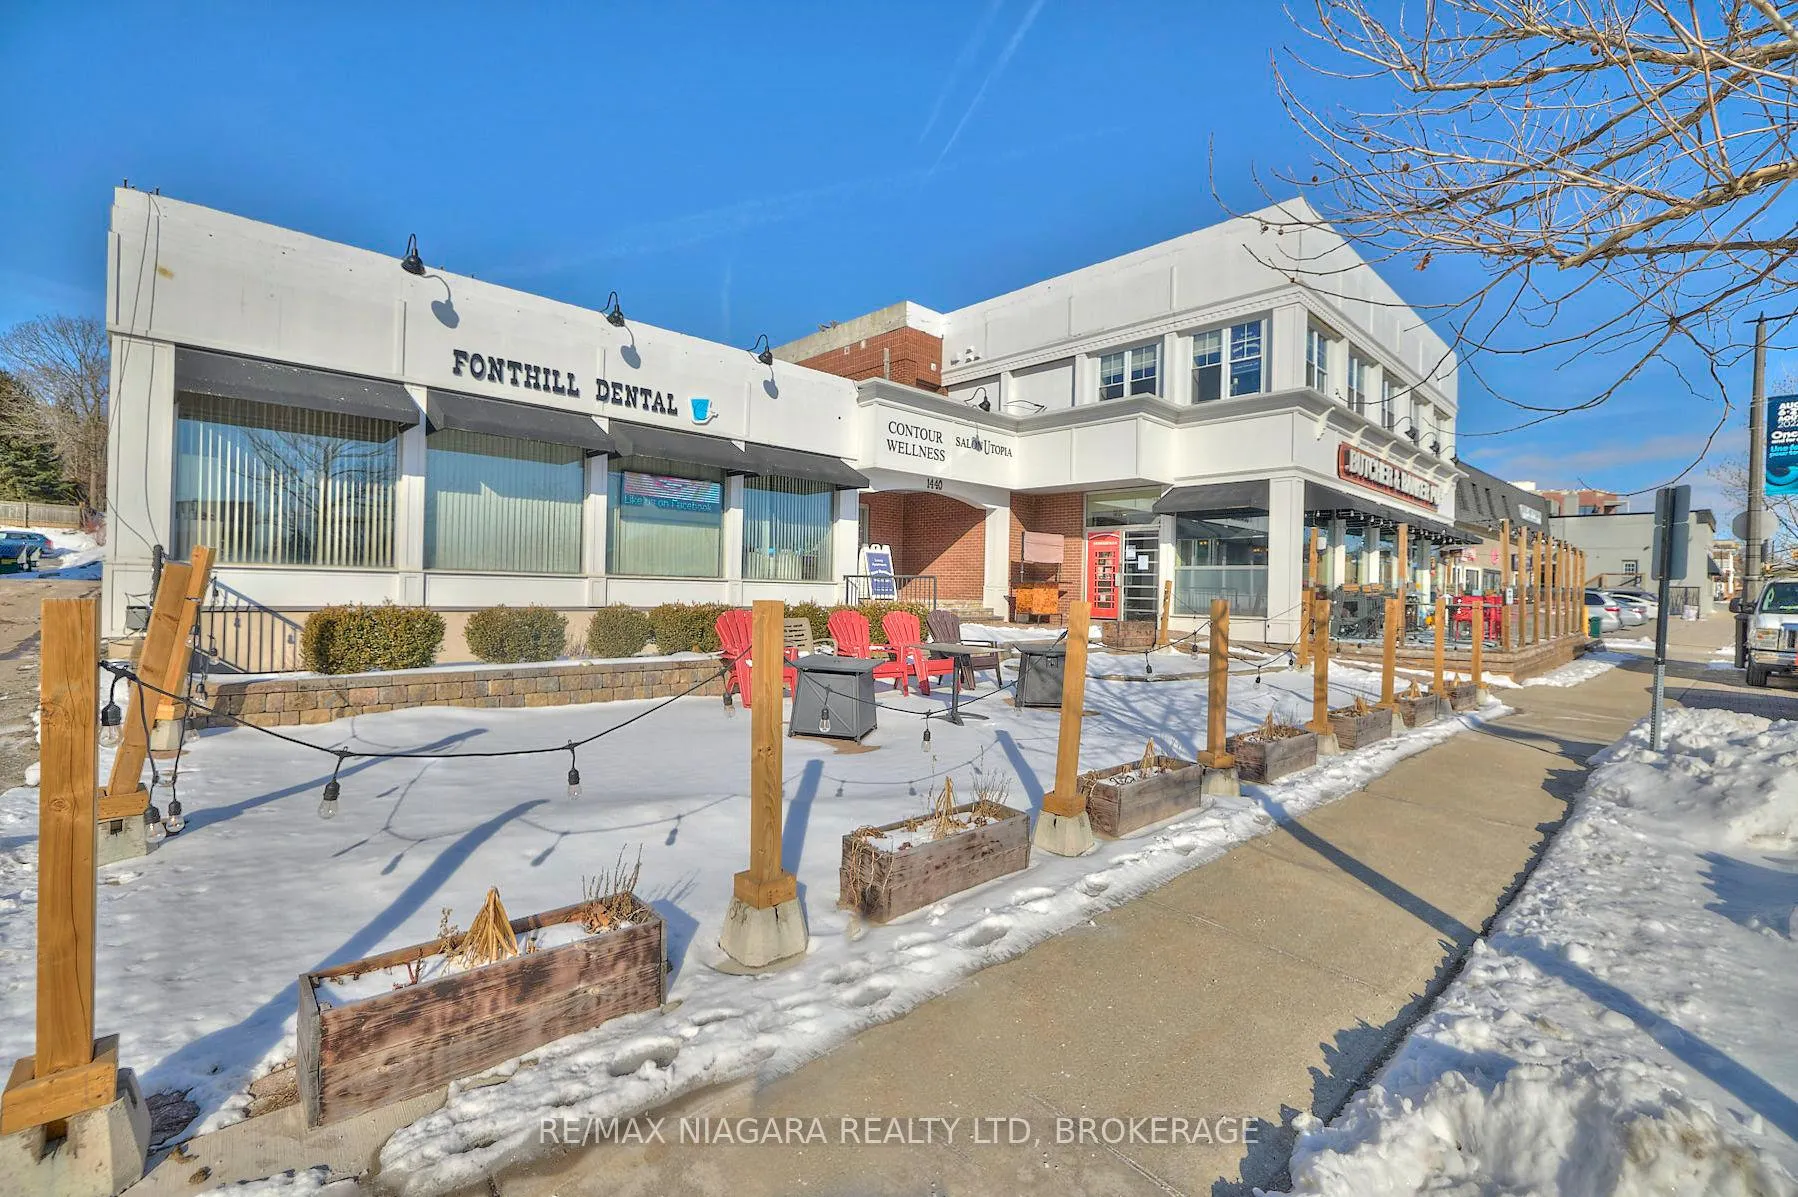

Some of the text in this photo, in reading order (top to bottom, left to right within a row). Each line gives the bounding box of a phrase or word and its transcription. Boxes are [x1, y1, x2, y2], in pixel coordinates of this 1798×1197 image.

[452, 349, 678, 416] FONTHILL DENTAL
[888, 421, 943, 444] CONTOUR
[886, 438, 946, 462] WELLNESS
[955, 436, 1013, 457] SALON UTOPIA
[1349, 448, 1394, 489] BUTCHER
[1394, 467, 1401, 492] &
[926, 477, 943, 491] 1440
[624, 494, 643, 504] Like
[658, 499, 669, 508] on
[671, 499, 712, 512] Facebook
